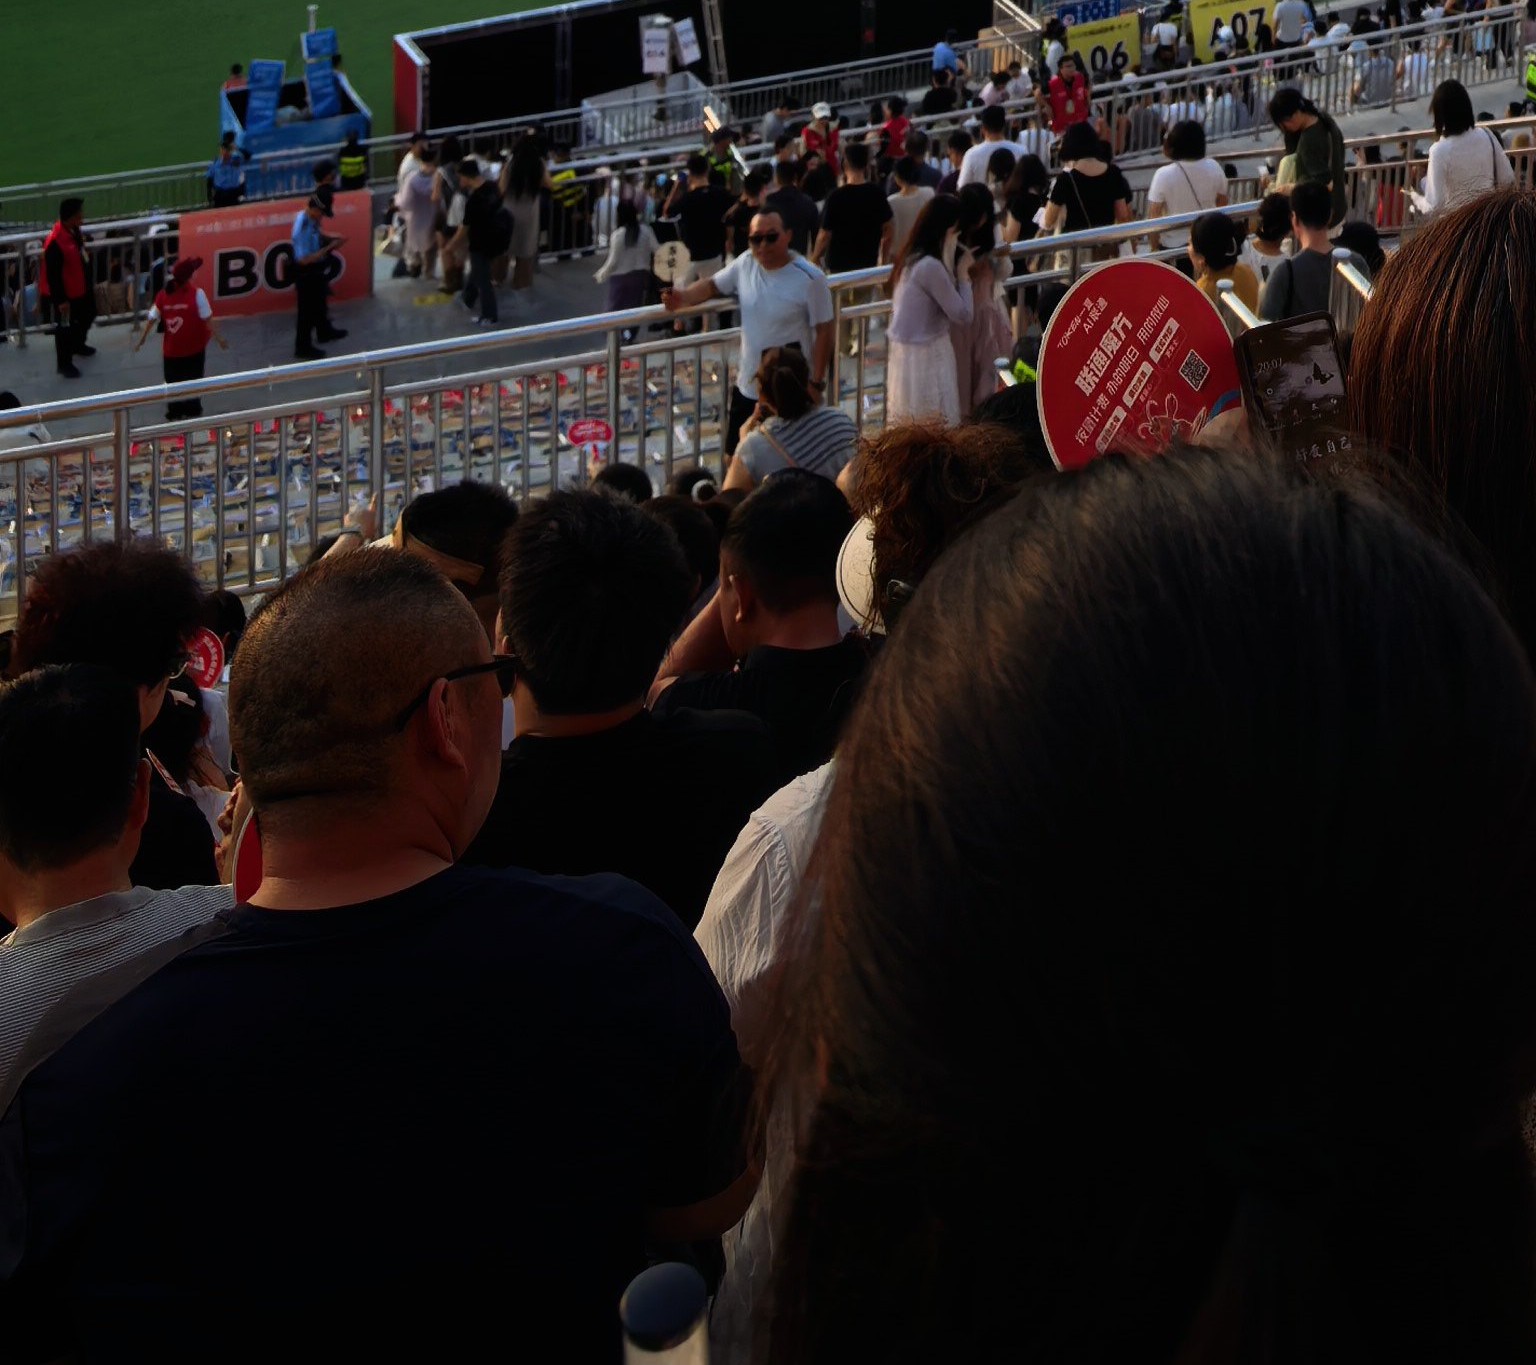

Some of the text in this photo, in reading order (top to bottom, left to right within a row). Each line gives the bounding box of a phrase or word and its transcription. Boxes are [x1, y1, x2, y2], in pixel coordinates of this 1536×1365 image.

[1073, 392, 1110, 446] 按量计费
[1104, 344, 1141, 396] 办的明白
[1135, 294, 1171, 345] 用的放心
[1074, 311, 1134, 398] 联通魔方
